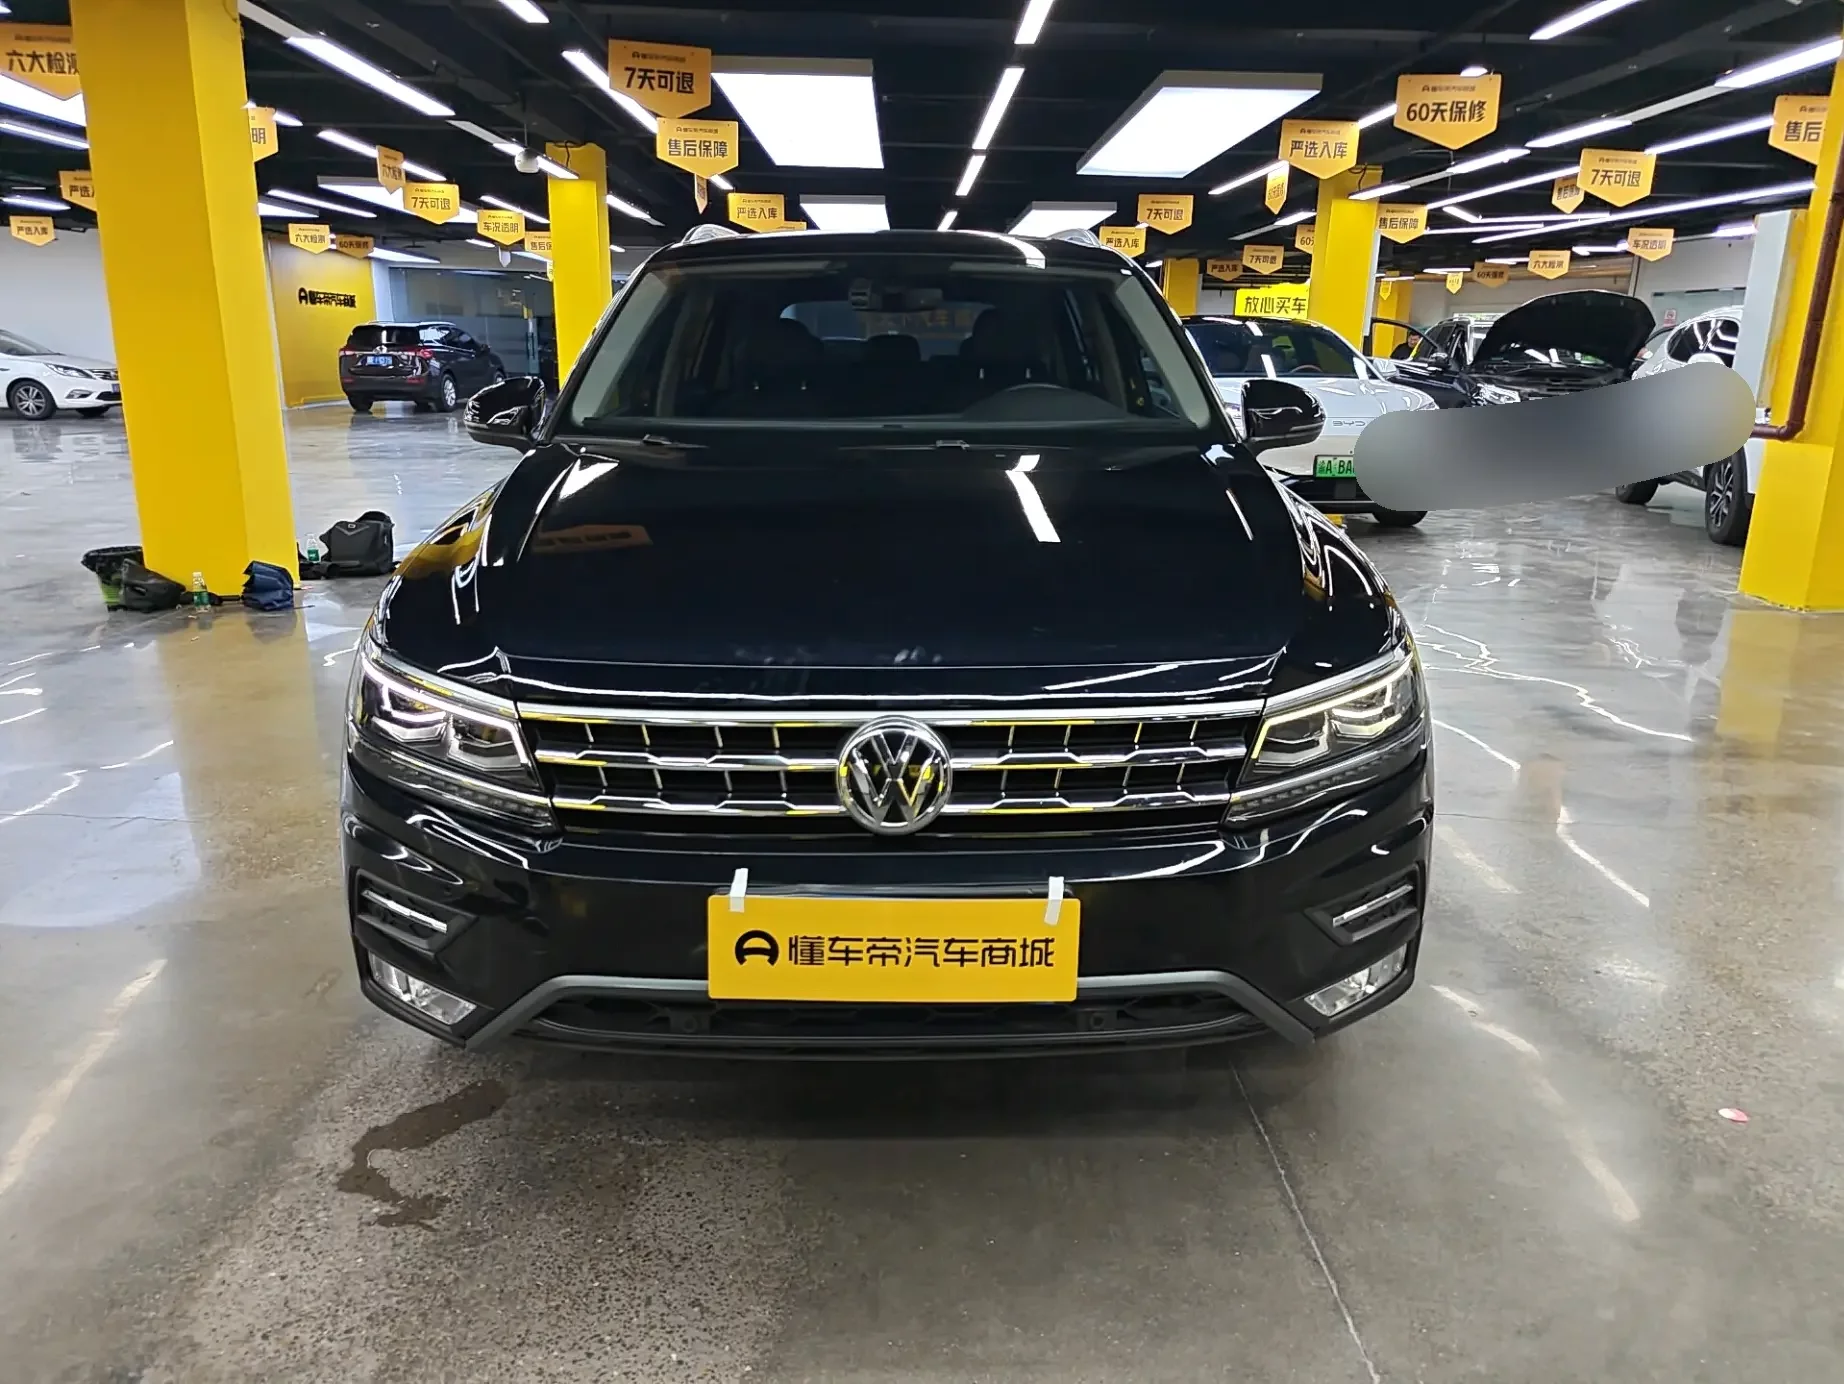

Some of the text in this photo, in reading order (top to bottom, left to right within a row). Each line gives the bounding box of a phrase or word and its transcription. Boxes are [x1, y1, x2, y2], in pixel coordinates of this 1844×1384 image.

[624, 66, 694, 94] 7天可退
[1406, 100, 1487, 122] 60天保修
[1784, 120, 1822, 142] 售后
[667, 138, 728, 158] 售后保障
[1289, 139, 1348, 159] 严选入库
[1591, 168, 1642, 188] 7天可退
[411, 196, 451, 211] 7天可退
[736, 206, 778, 220] 严选入库
[1146, 208, 1184, 221] 7天可退
[1378, 216, 1419, 230] 售后保障
[483, 221, 519, 233] 车况透明
[1105, 237, 1140, 249] 严选入库
[1244, 295, 1307, 315] 放心买车
[788, 935, 1056, 968] 懂车帝汽车商城
